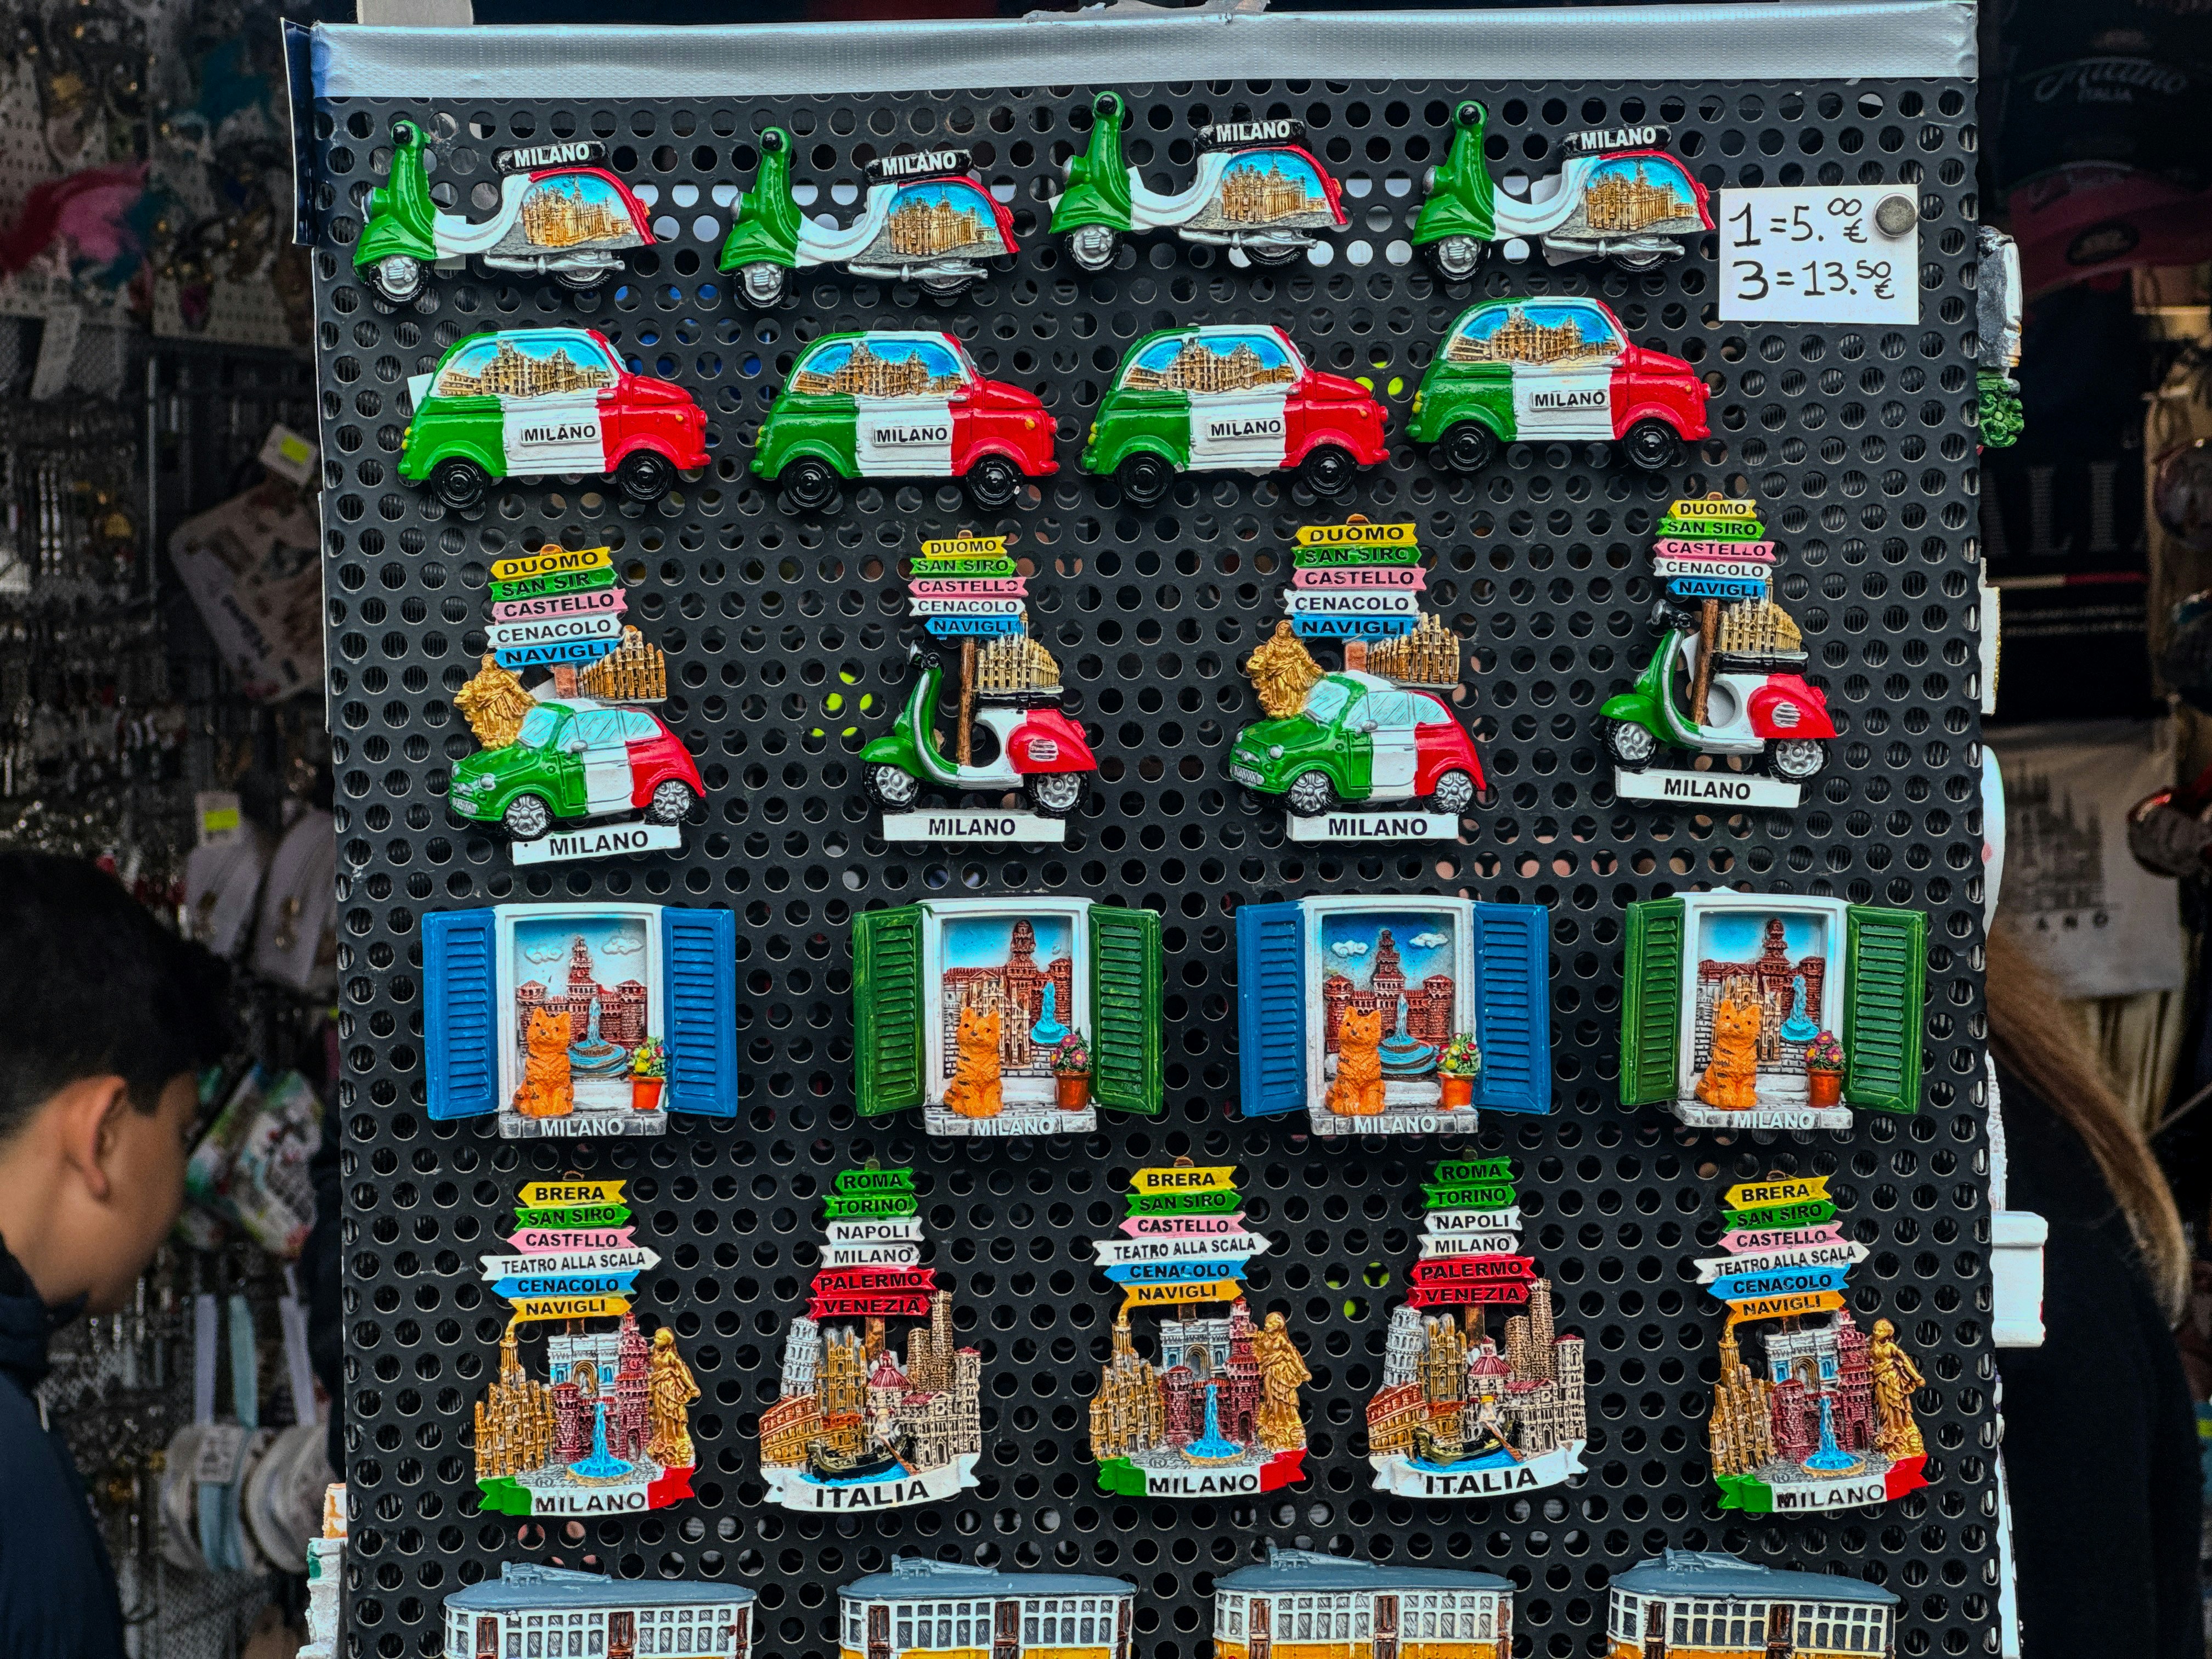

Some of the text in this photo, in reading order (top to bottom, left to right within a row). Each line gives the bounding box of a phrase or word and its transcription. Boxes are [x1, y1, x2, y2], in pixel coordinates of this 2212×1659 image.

[1216, 120, 1290, 143] MILANO
[1581, 127, 1656, 150] MILANO
[514, 143, 589, 167] MILANO
[882, 152, 957, 176] MILANO
[1537, 391, 1605, 407] MILANO
[524, 425, 595, 442] MILANO
[876, 427, 947, 442] MILANO
[1211, 419, 1281, 437] MILANO
[1680, 503, 1747, 515] DUOMO
[1310, 526, 1404, 543] DUOMO
[1668, 520, 1757, 536] SAN SIRO
[930, 540, 996, 554] DUOMO
[1667, 541, 1767, 557] CASTELLO
[504, 552, 599, 575] DUOMO
[1304, 549, 1409, 563] SAN SIRO
[917, 559, 1008, 572] SAN SIRO
[1666, 561, 1764, 578] CENACOLO
[918, 579, 1018, 592] CASTELLO
[1305, 571, 1414, 585] CASTELLO
[502, 580, 546, 597] SAN
[1679, 580, 1757, 597] NAVIGLI
[504, 593, 614, 618] CASTELLO
[918, 600, 1018, 613] CENACOLO
[1295, 596, 1409, 611] CENACOLO
[497, 619, 611, 643] CENACOLO
[934, 619, 1012, 633] NAVIGLI
[1302, 620, 1405, 635] NAVIGLI
[505, 642, 610, 664] NAVIGLI
[1664, 778, 1751, 800] MILANO
[928, 818, 1015, 836] MILANO
[1328, 818, 1429, 836] MILANO
[549, 830, 649, 856] MILANO
[540, 1118, 624, 1137] MILANO
[974, 1118, 1055, 1136] MILANO
[1354, 1116, 1436, 1135] MILANO
[1735, 1111, 1814, 1130] MILANO
[1147, 1173, 1216, 1187] BRERA
[1442, 1164, 1502, 1180] ROMA
[843, 1173, 903, 1189] ROMA
[535, 1186, 605, 1201] BRERA
[1436, 1188, 1506, 1204] TORINO
[1741, 1184, 1810, 1203] BRERA
[834, 1199, 909, 1215] TORINO
[1140, 1194, 1226, 1211] SAN SIRO
[528, 1207, 617, 1226] SAN SIRO
[1437, 1215, 1509, 1229] NAPOLI
[1736, 1205, 1822, 1228] SAN SIRO
[837, 1225, 910, 1239] NAPOLI
[1137, 1218, 1229, 1233] CASTELLO
[1435, 1238, 1510, 1253] MILANO
[1736, 1230, 1827, 1248] CASTELLO
[834, 1249, 911, 1263] MILANO
[1114, 1237, 1256, 1261] TEATRO ALLA SCALA
[502, 1252, 646, 1274] TEATRO ALLA SCALA
[1716, 1246, 1856, 1276] TEATRO ALLA SCALA
[1130, 1265, 1230, 1278] CENACOLO
[1421, 1262, 1522, 1280] PALERMO
[517, 1279, 619, 1293] CENACOLO
[821, 1272, 923, 1290] PALERMO
[1733, 1274, 1832, 1293] CENACOLO
[1138, 1284, 1217, 1301] NAVIGLI
[1427, 1286, 1520, 1302] VENEZIA
[526, 1299, 605, 1315] NAVIGLI
[824, 1299, 921, 1313] VENEZIA
[1742, 1295, 1821, 1315] NAVIGLI
[1148, 1474, 1258, 1493] MILANO
[1426, 1468, 1538, 1495] ITALIA
[535, 1492, 646, 1514] MILANO
[816, 1481, 930, 1508] ITALIA
[1777, 1485, 1885, 1509] MILANO
